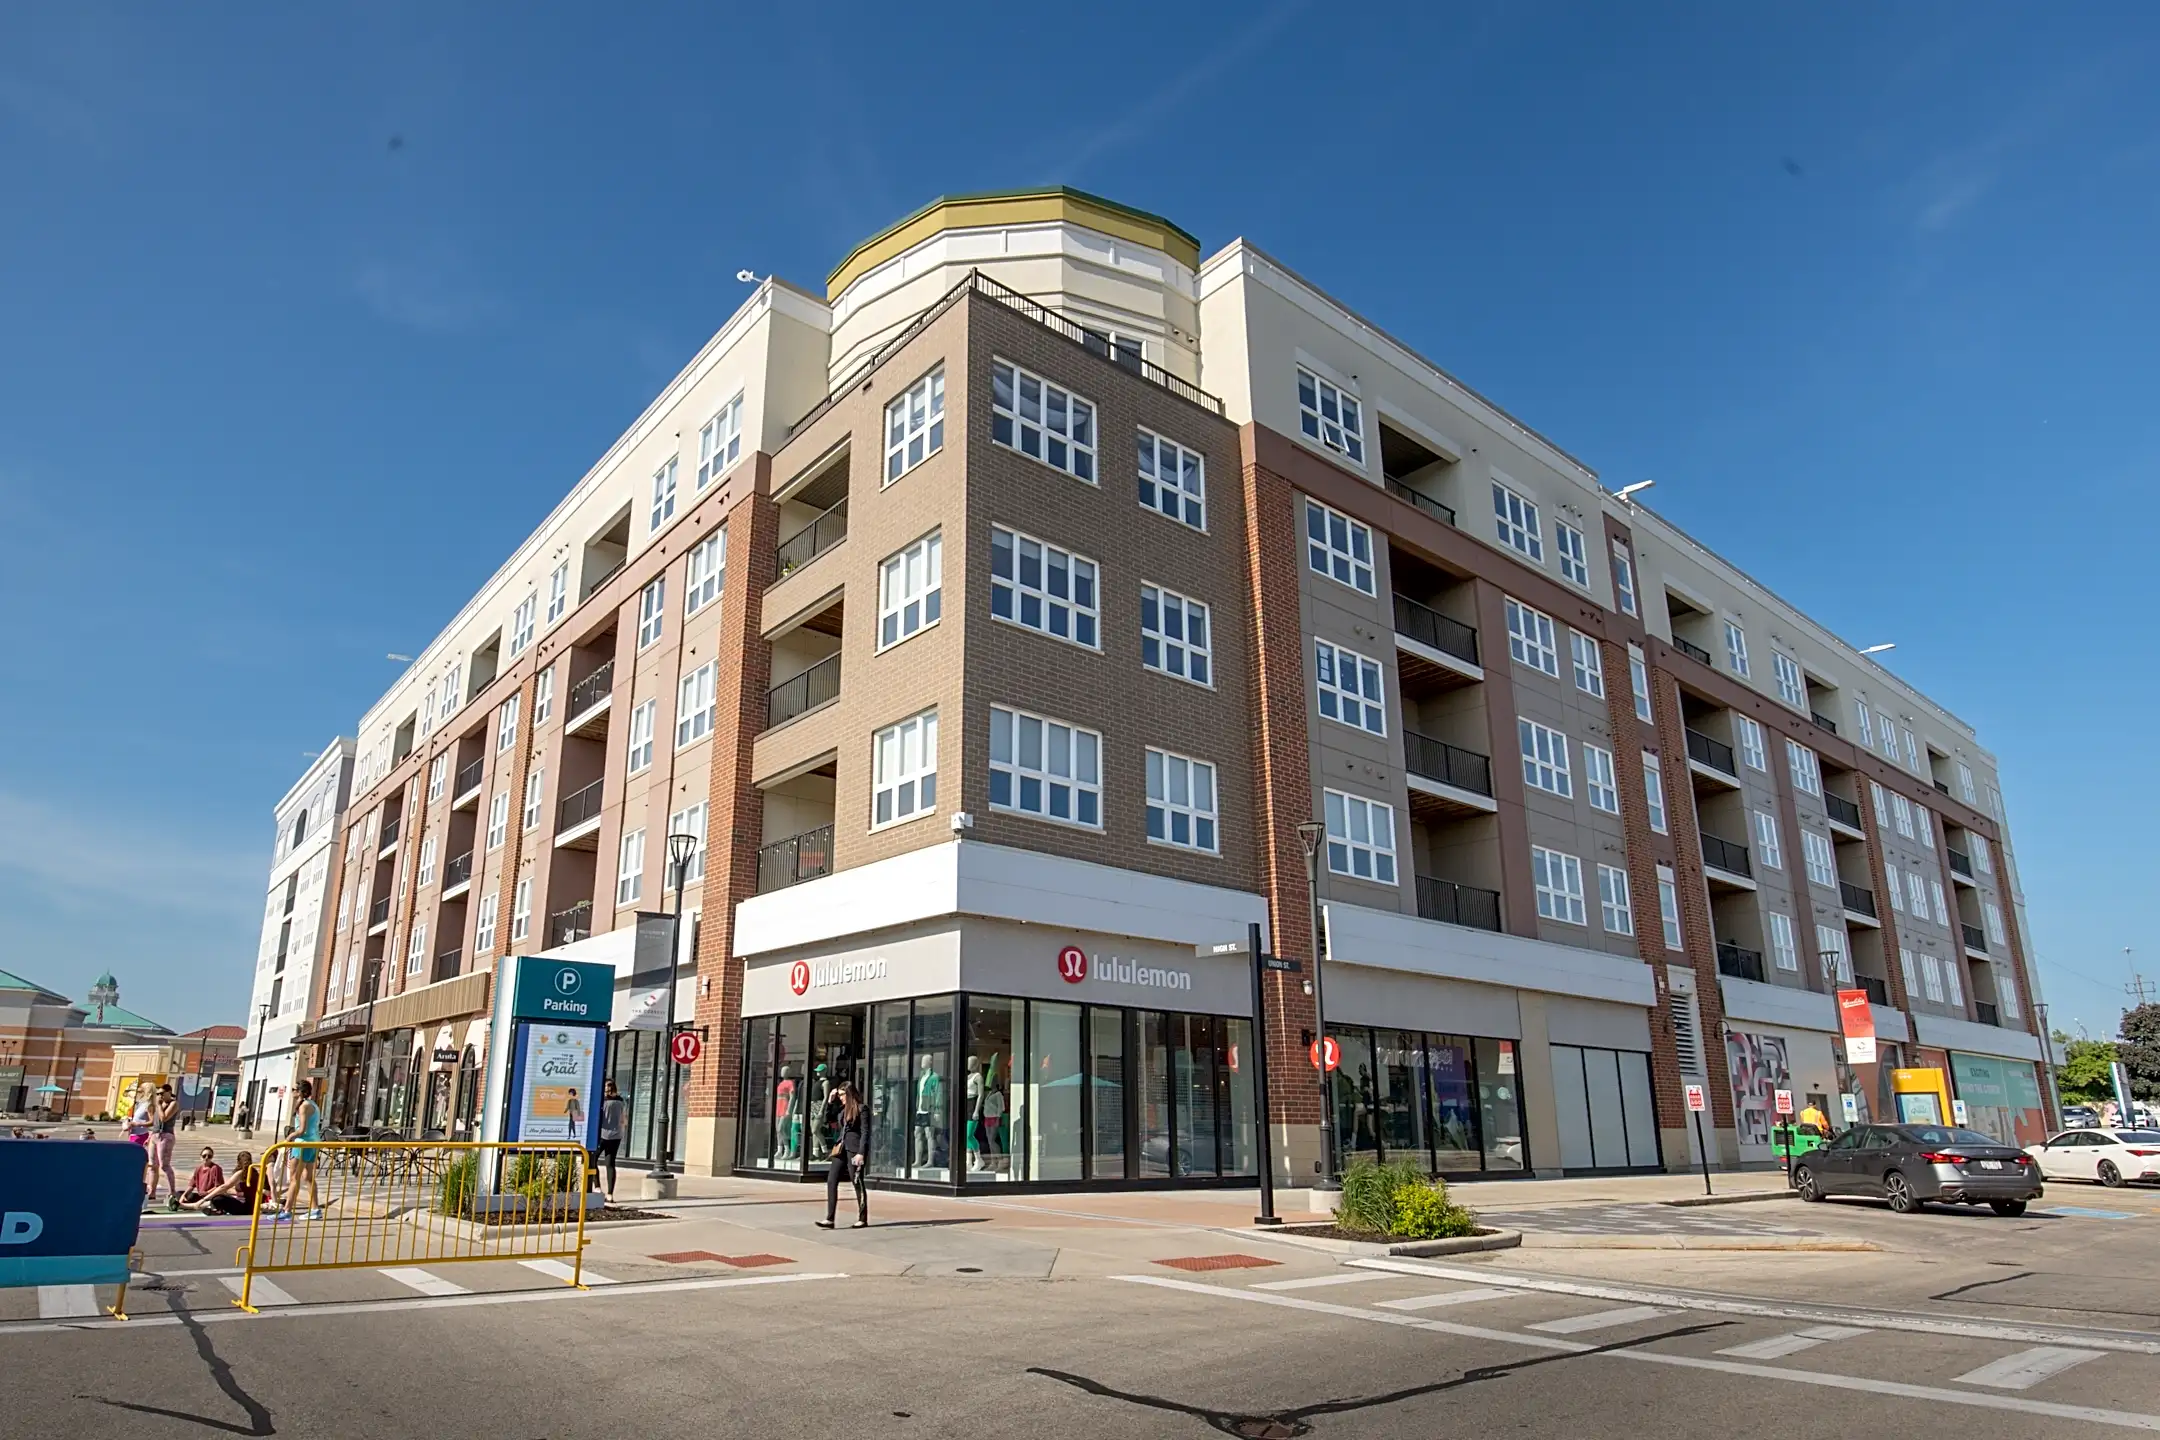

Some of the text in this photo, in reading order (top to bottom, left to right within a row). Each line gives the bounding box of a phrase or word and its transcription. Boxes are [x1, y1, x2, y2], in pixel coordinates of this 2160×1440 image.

[1213, 943, 1237, 953] HIGH ST.
[812, 957, 887, 988] lululemon
[1093, 954, 1191, 990] lululemon
[1268, 960, 1291, 970] UNION ST.
[562, 972, 576, 990] P
[543, 998, 587, 1015] Parking
[542, 1060, 578, 1076] Grad
